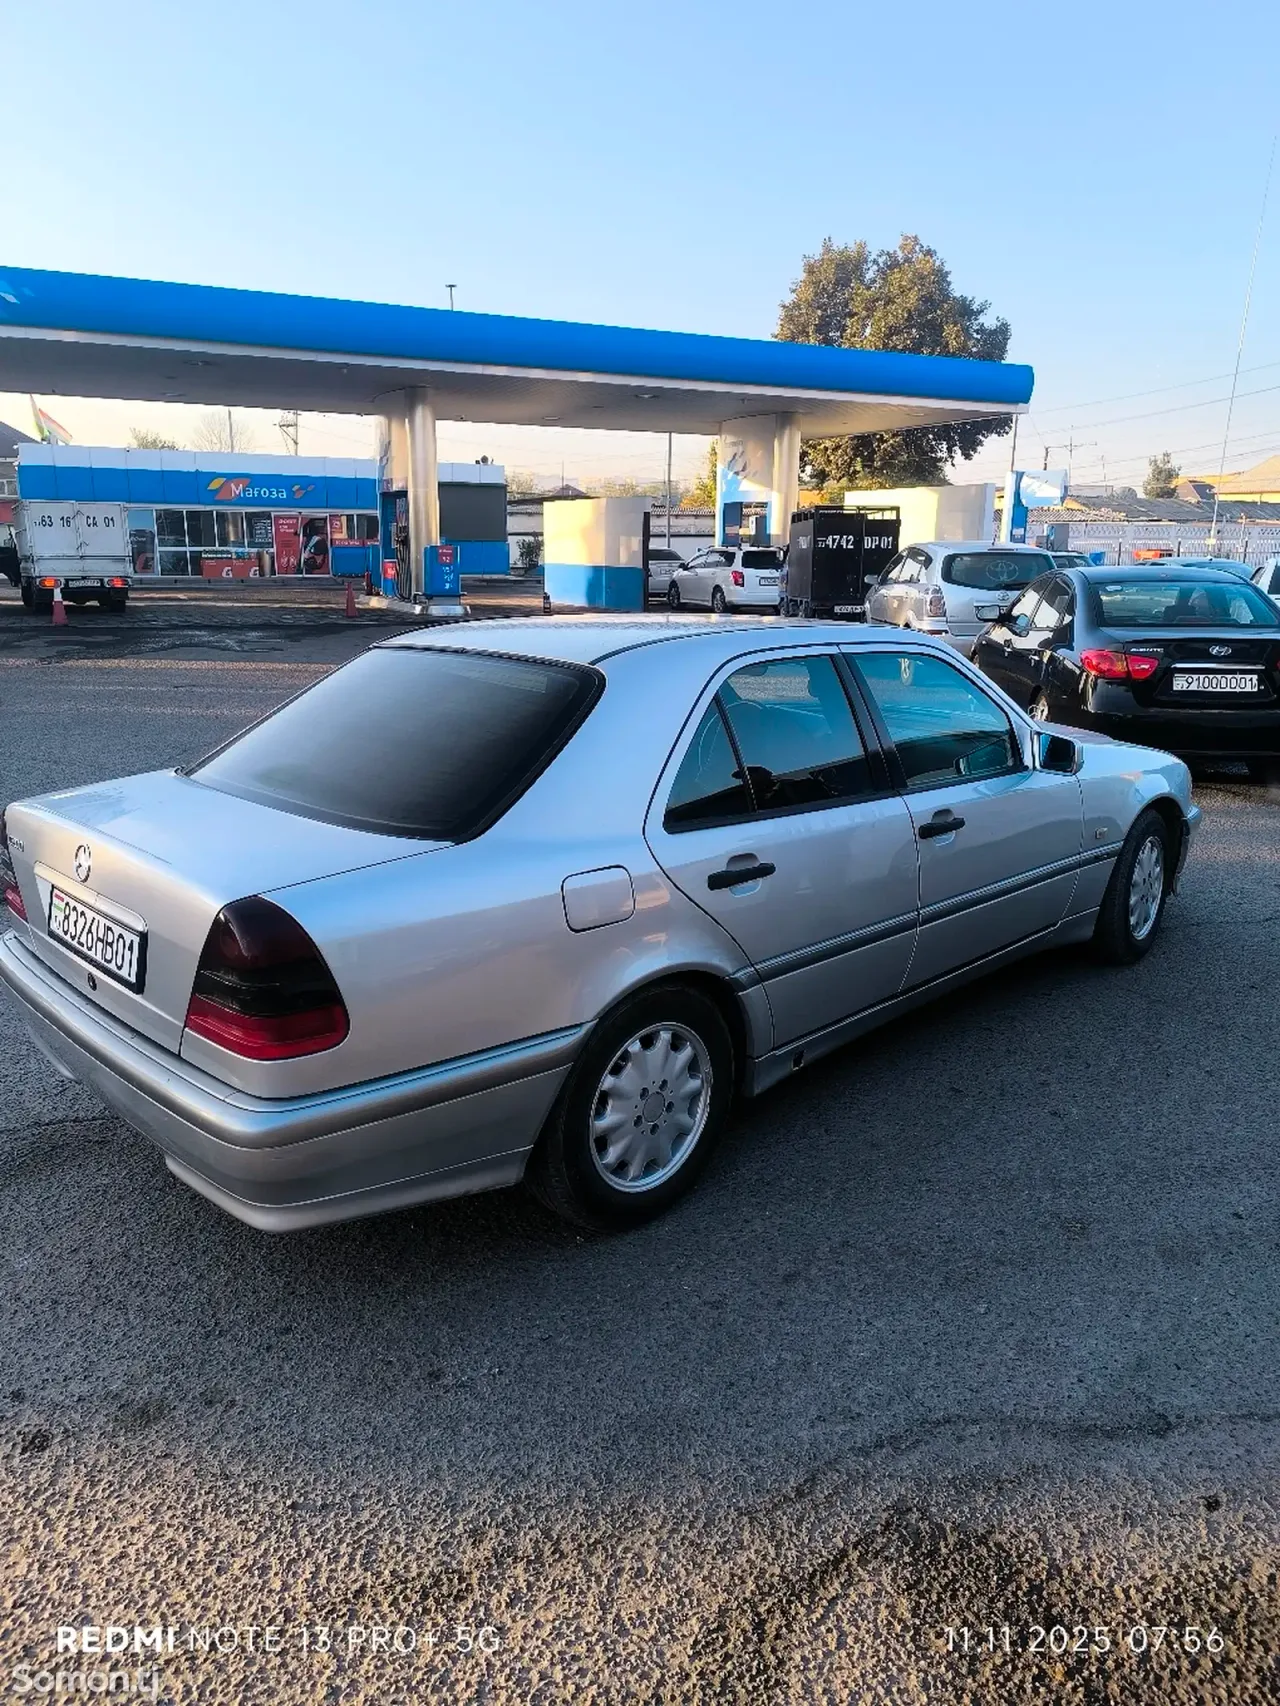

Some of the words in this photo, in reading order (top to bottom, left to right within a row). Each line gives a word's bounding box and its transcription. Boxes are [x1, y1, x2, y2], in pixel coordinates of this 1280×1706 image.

[41, 515, 54, 528] 63
[60, 516, 71, 528] 16
[104, 516, 115, 528] 01
[826, 535, 854, 549] 4742
[62, 901, 135, 978] 8326HB01
